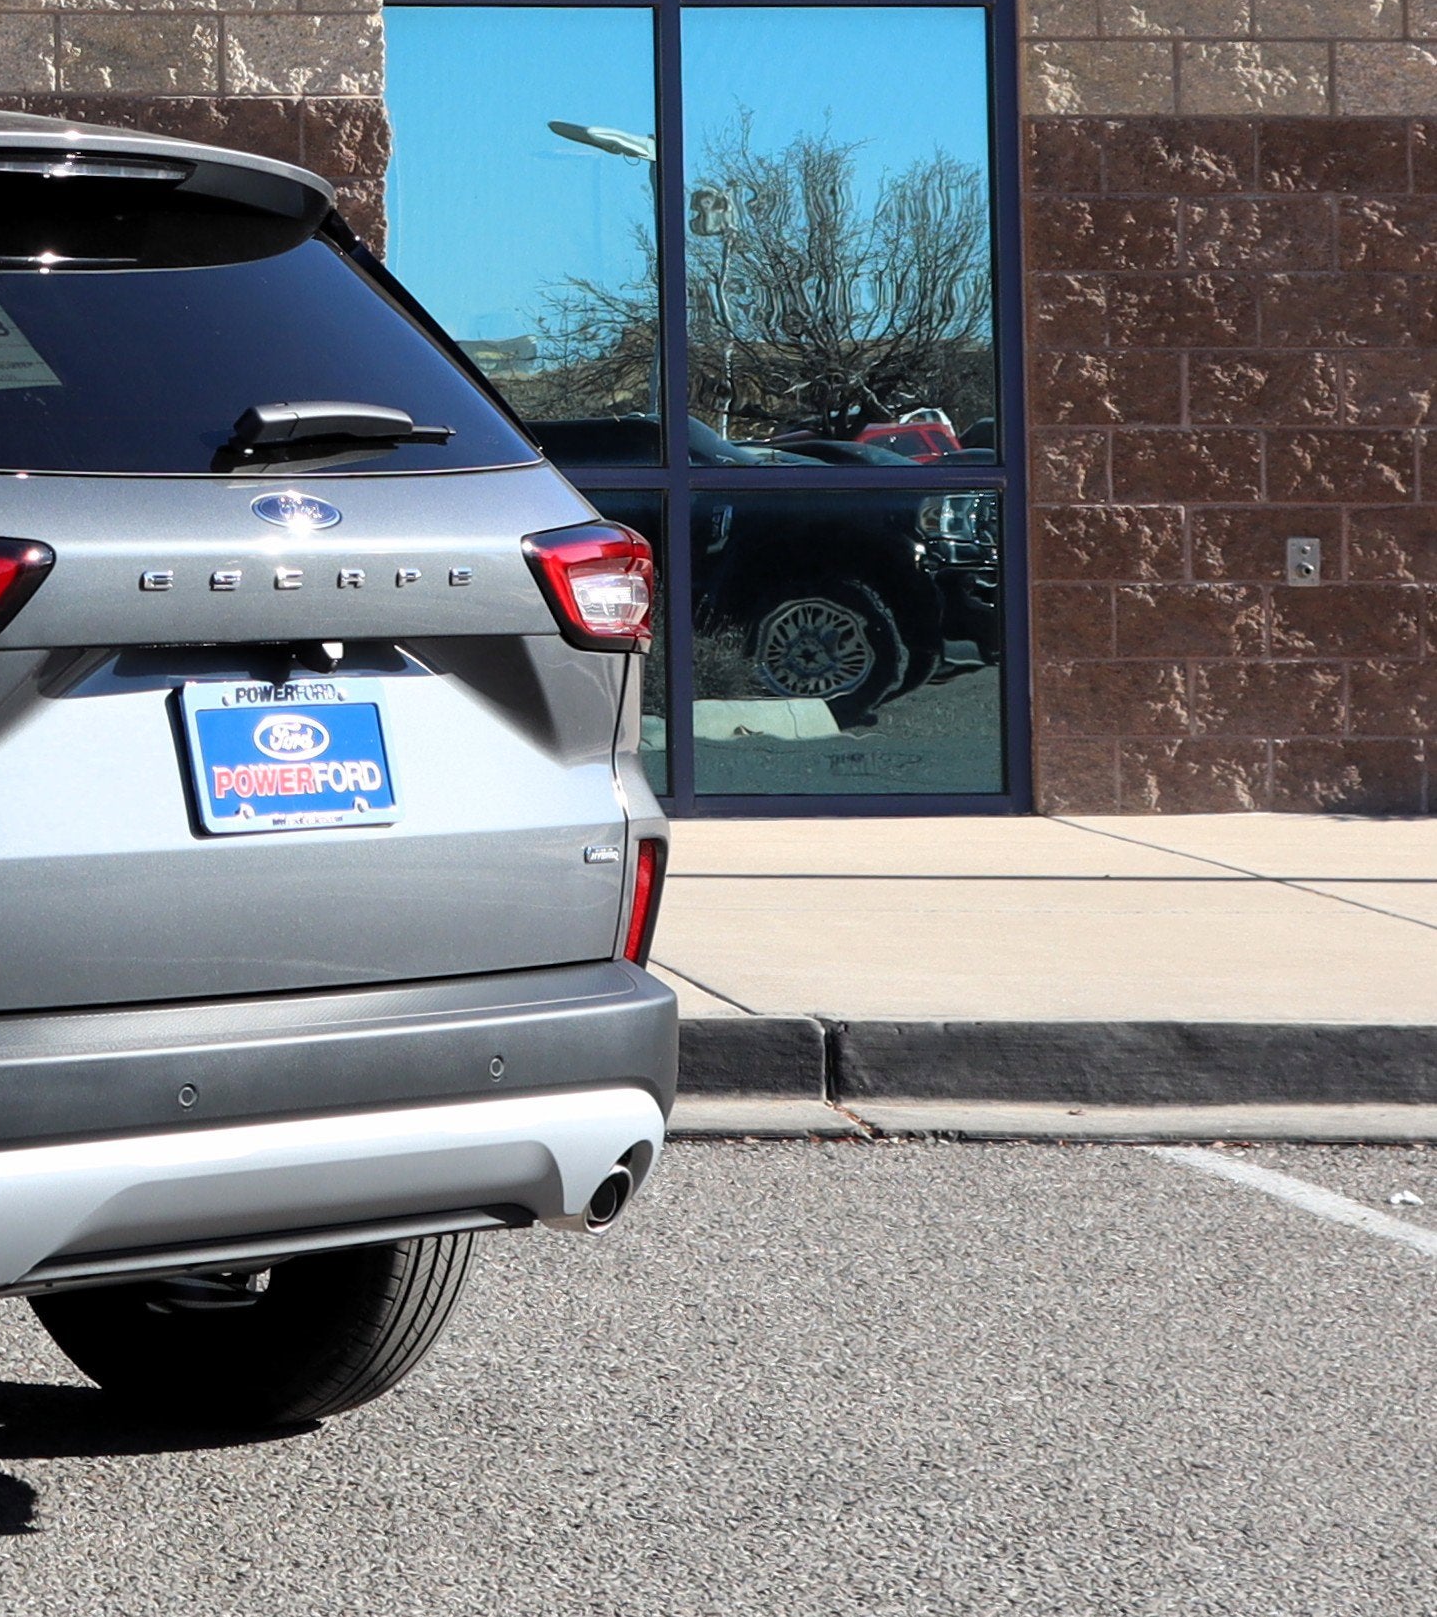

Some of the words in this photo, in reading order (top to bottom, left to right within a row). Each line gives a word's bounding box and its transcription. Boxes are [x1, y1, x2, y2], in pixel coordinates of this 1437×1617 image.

[141, 566, 473, 590] ESCAPE
[269, 721, 316, 752] Ford
[212, 760, 382, 799] POWERFORD
